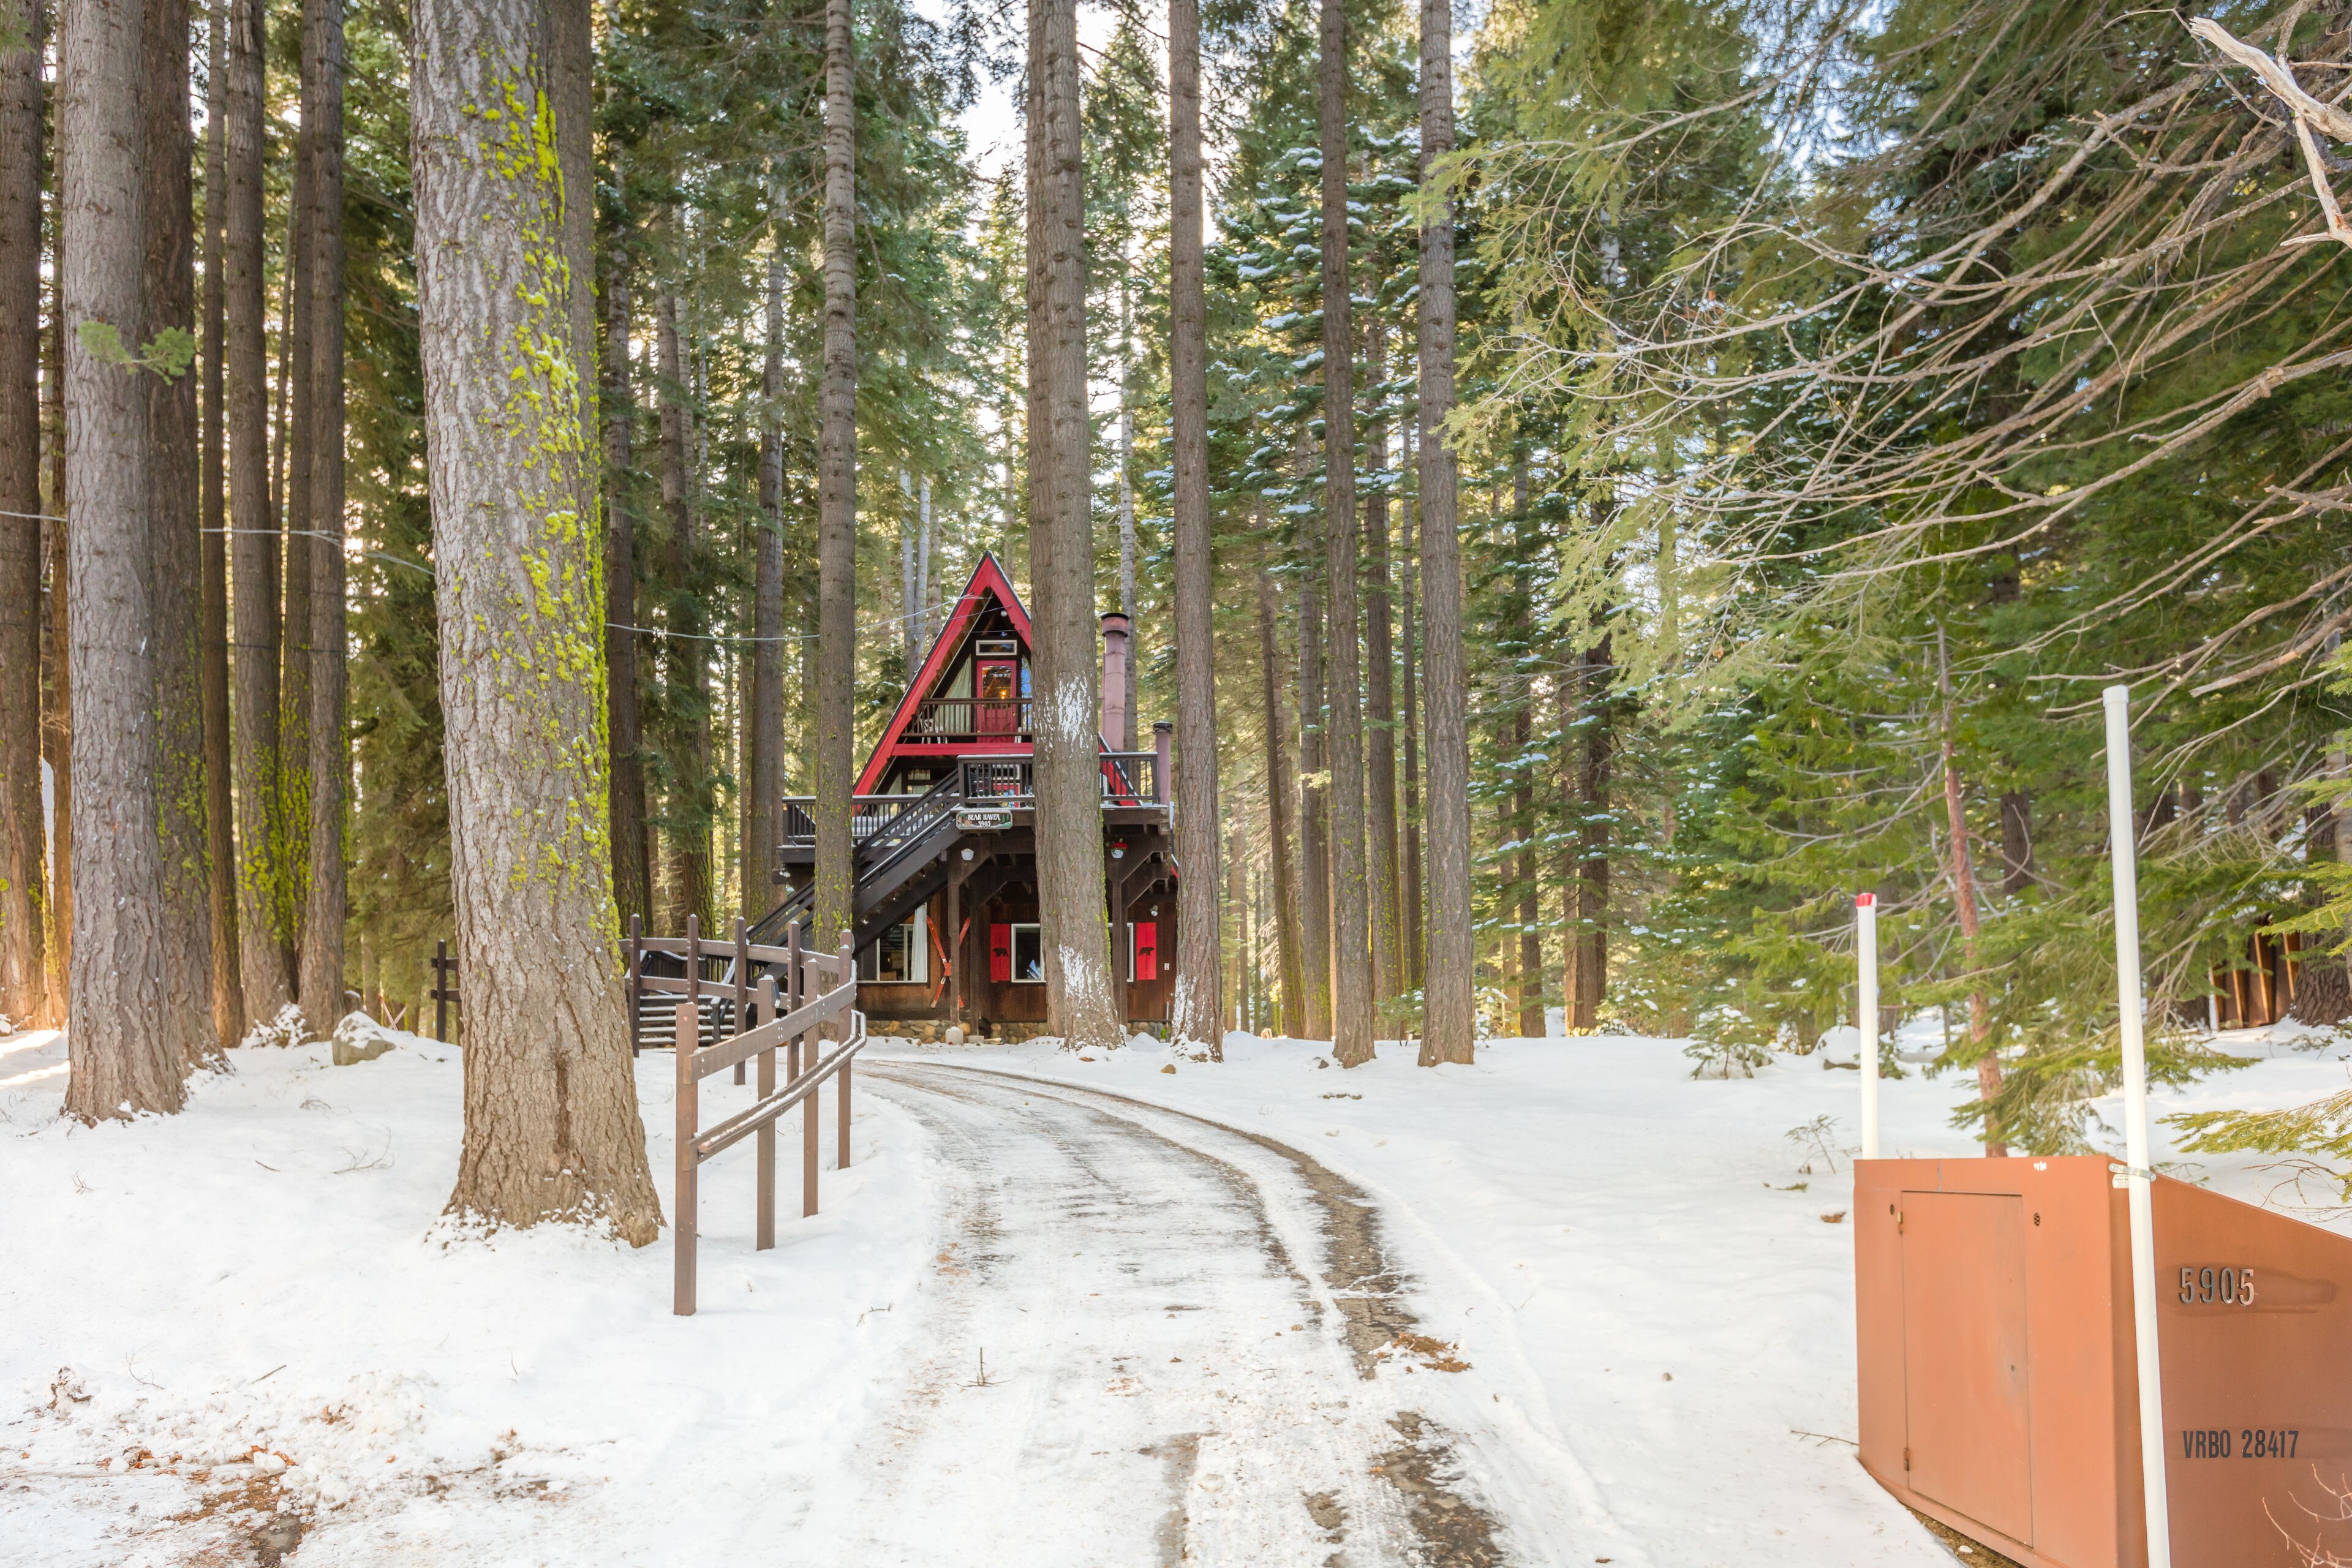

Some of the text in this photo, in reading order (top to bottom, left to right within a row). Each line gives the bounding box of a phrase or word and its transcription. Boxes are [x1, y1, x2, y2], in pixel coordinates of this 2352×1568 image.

[2179, 1267, 2255, 1306] 5905
[2182, 1430, 2299, 1458] VRBO 28417
